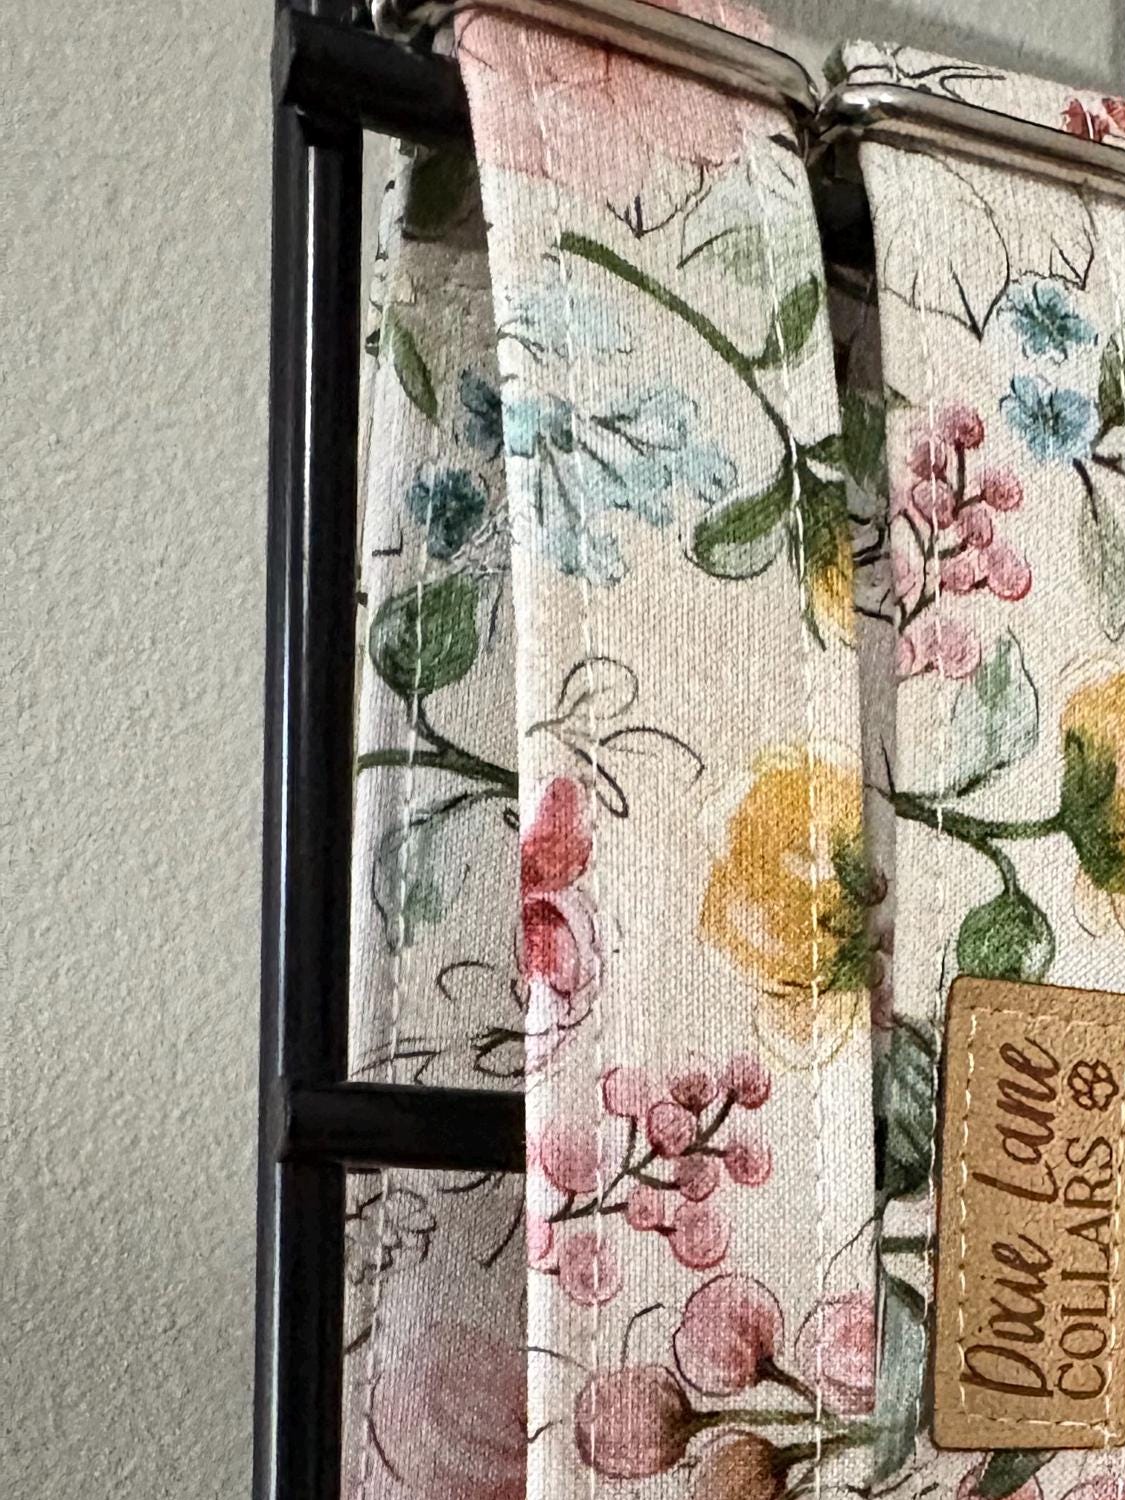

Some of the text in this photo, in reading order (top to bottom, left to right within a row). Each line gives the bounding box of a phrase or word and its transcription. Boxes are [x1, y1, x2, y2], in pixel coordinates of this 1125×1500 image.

[960, 1037, 1061, 1398] Dixie Lane
[1057, 1135, 1114, 1400] COLLARS
